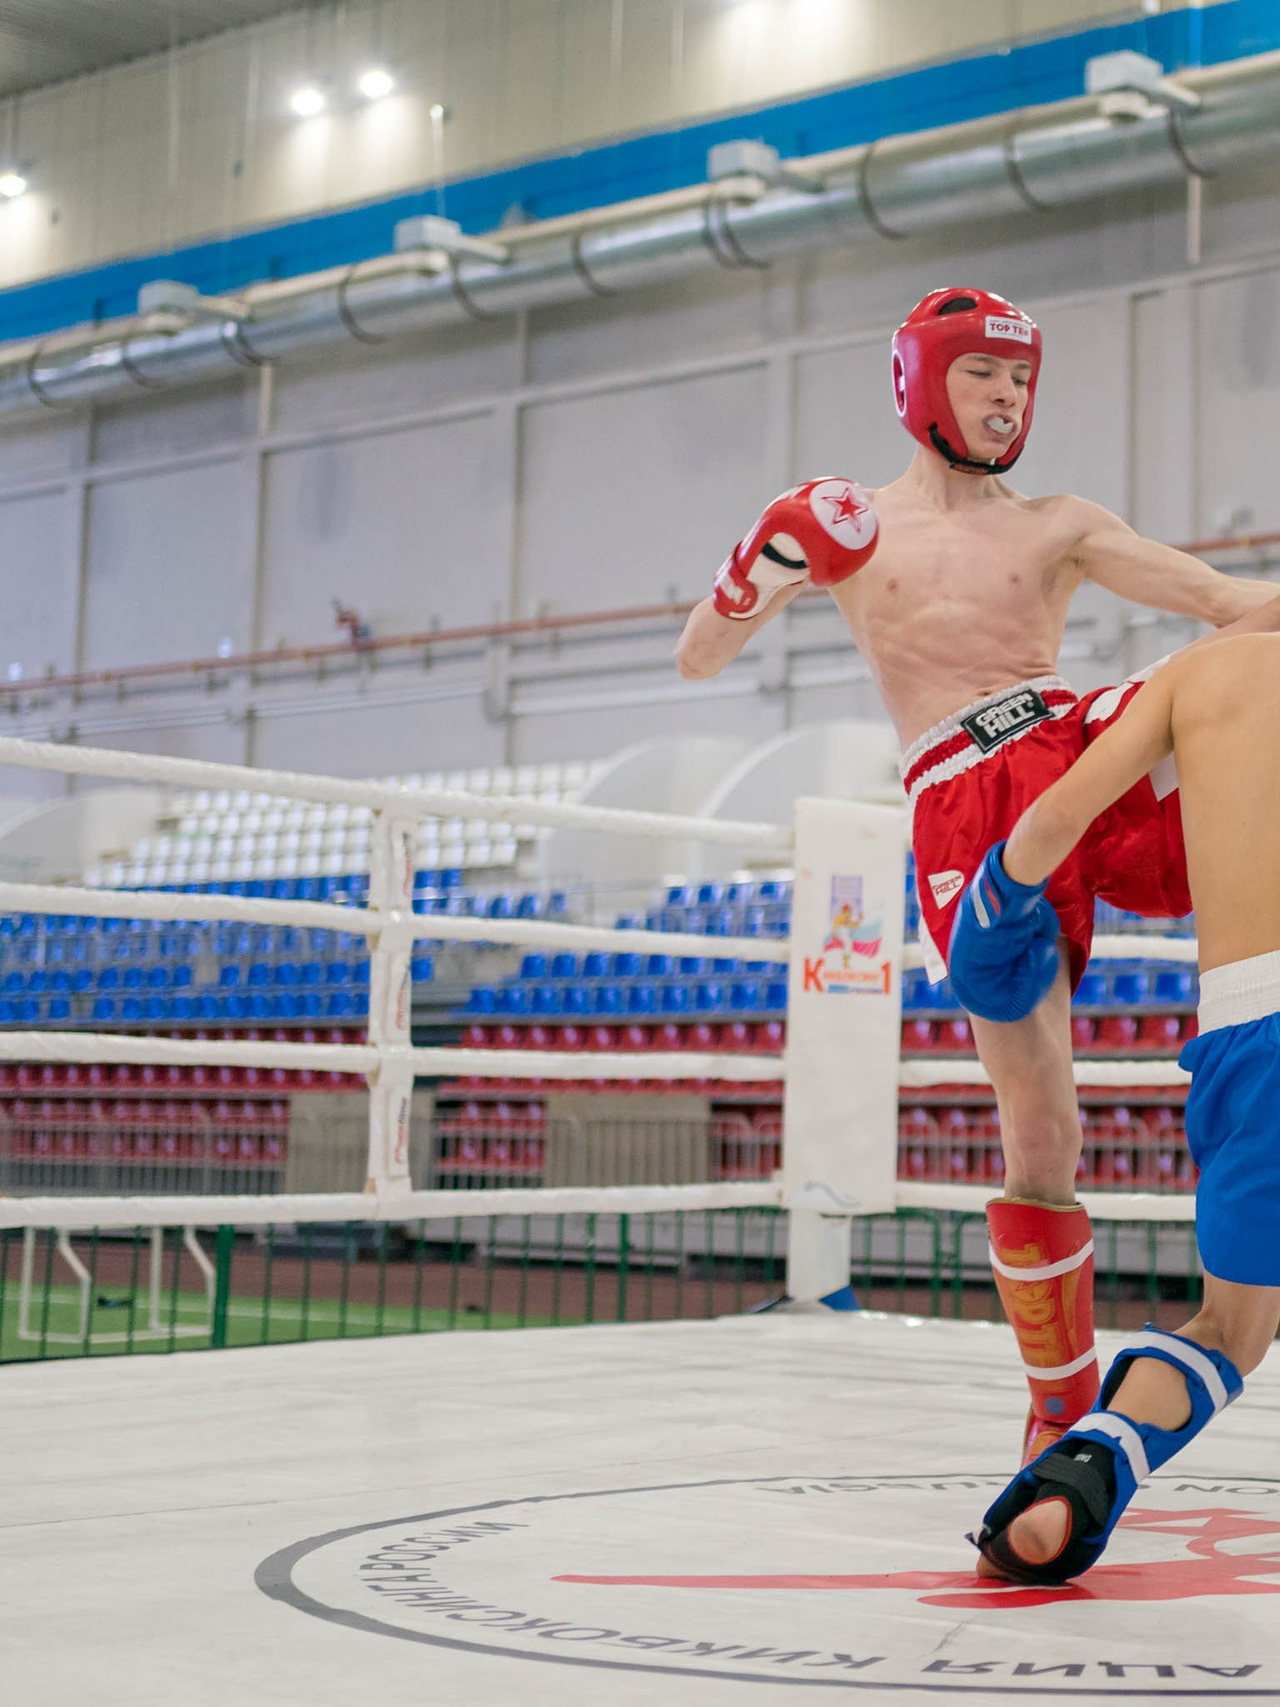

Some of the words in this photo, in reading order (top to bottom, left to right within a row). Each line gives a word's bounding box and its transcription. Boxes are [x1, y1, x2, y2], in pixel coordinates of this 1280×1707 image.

[989, 322, 1010, 332] TOP
[975, 692, 1033, 727] GREEN
[983, 704, 1036, 739] HILL
[359, 1521, 531, 1570] РОССИИ
[361, 1573, 887, 1669] КИКБОКСИНГА
